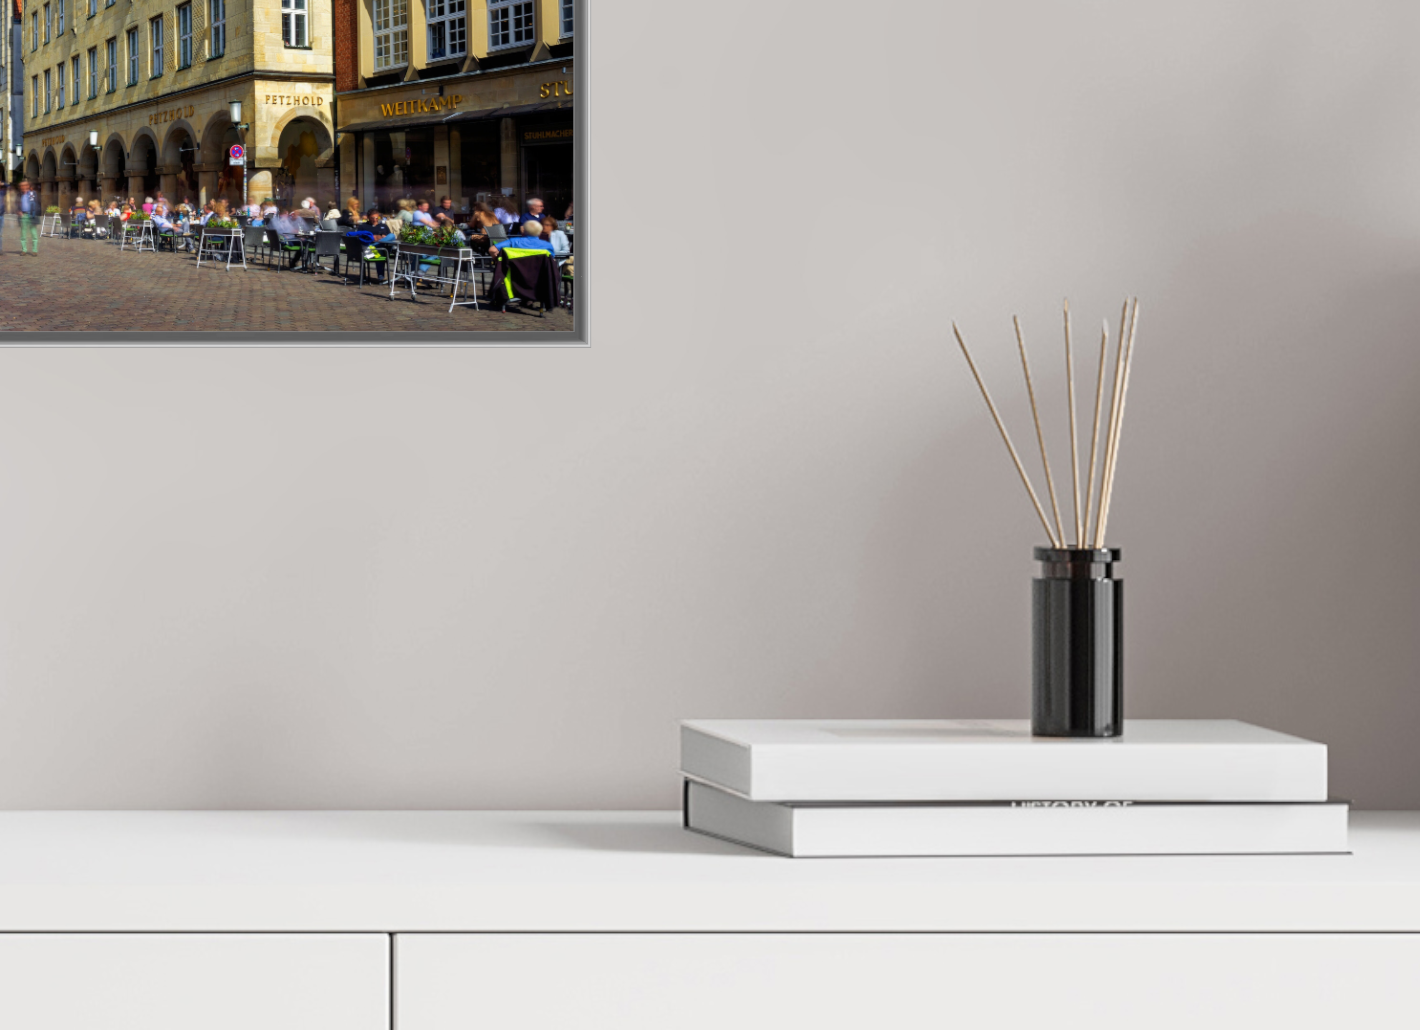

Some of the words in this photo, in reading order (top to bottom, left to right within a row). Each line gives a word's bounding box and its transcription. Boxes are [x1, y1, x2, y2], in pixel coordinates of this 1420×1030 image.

[265, 94, 324, 107] PETZHOLD
[381, 95, 463, 118] WEITKAMP
[148, 105, 195, 127] PETZHOLD
